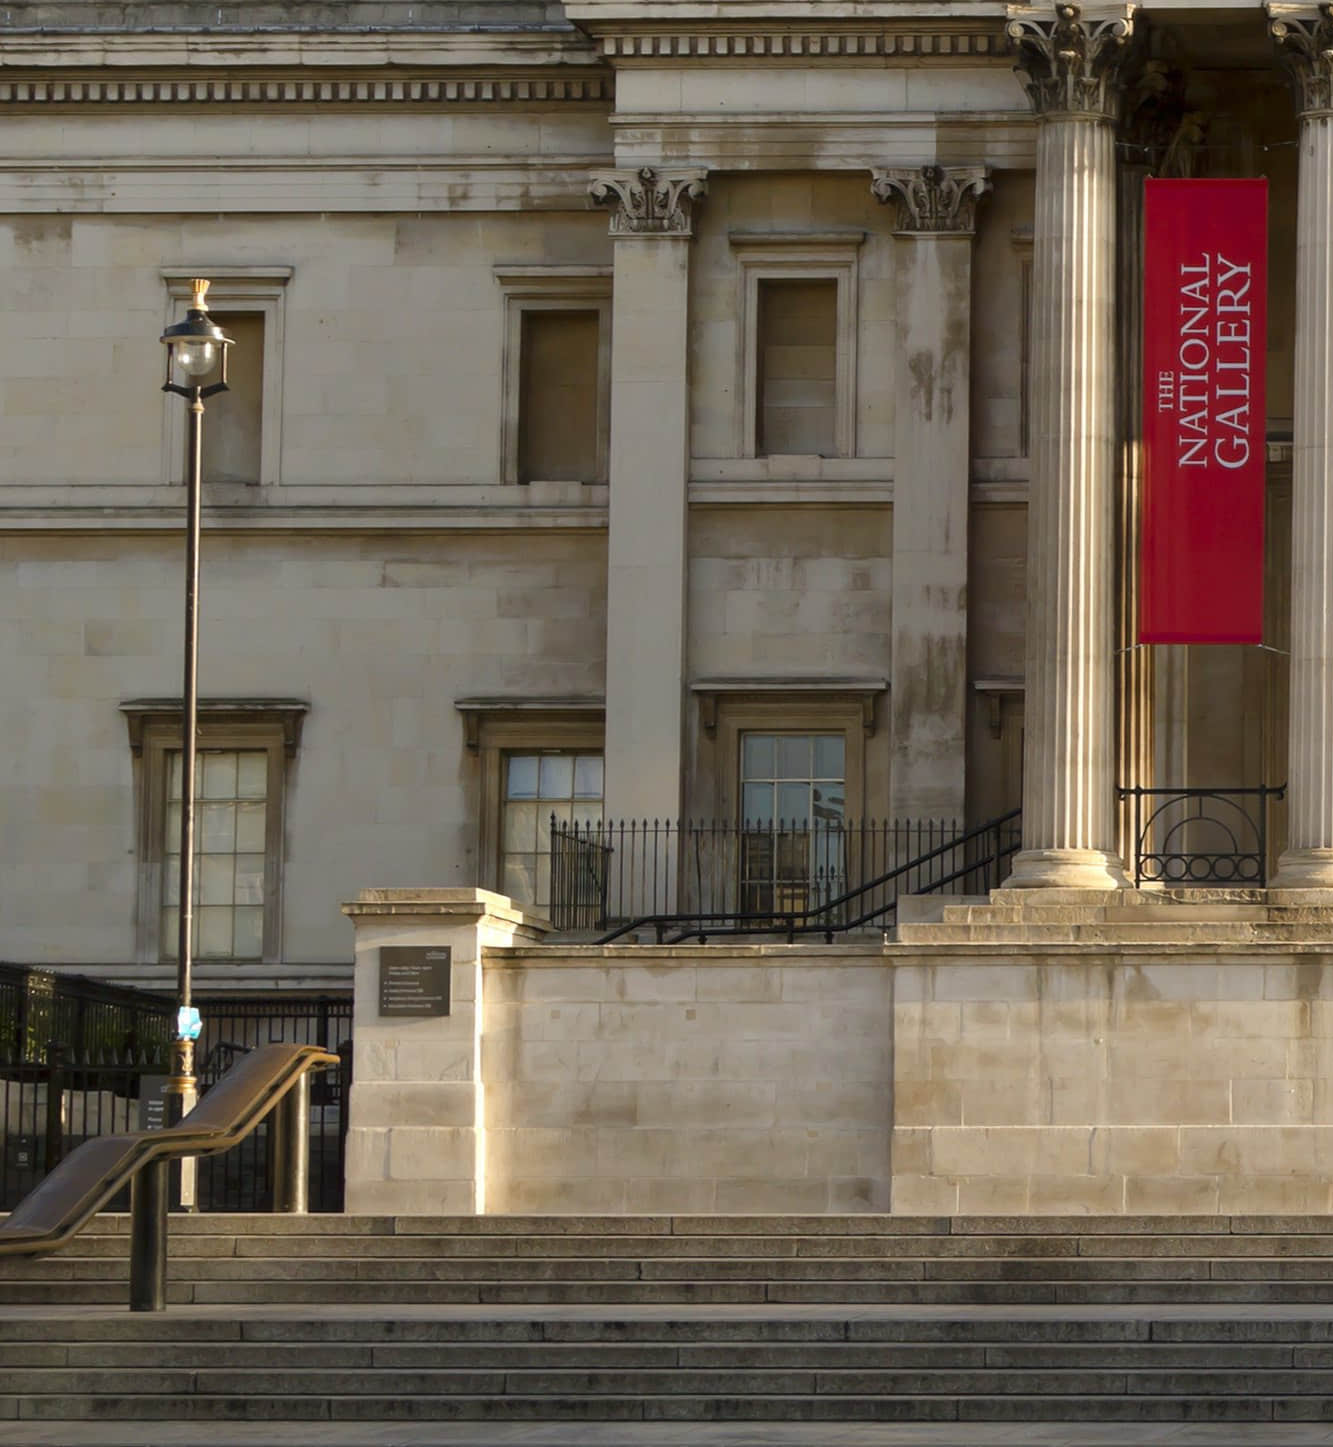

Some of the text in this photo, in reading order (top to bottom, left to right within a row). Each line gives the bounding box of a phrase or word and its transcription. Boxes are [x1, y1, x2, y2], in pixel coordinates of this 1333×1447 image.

[1158, 370, 1174, 413] THE
[1178, 252, 1210, 468] NATIONAL
[1214, 252, 1251, 469] GALLERY
